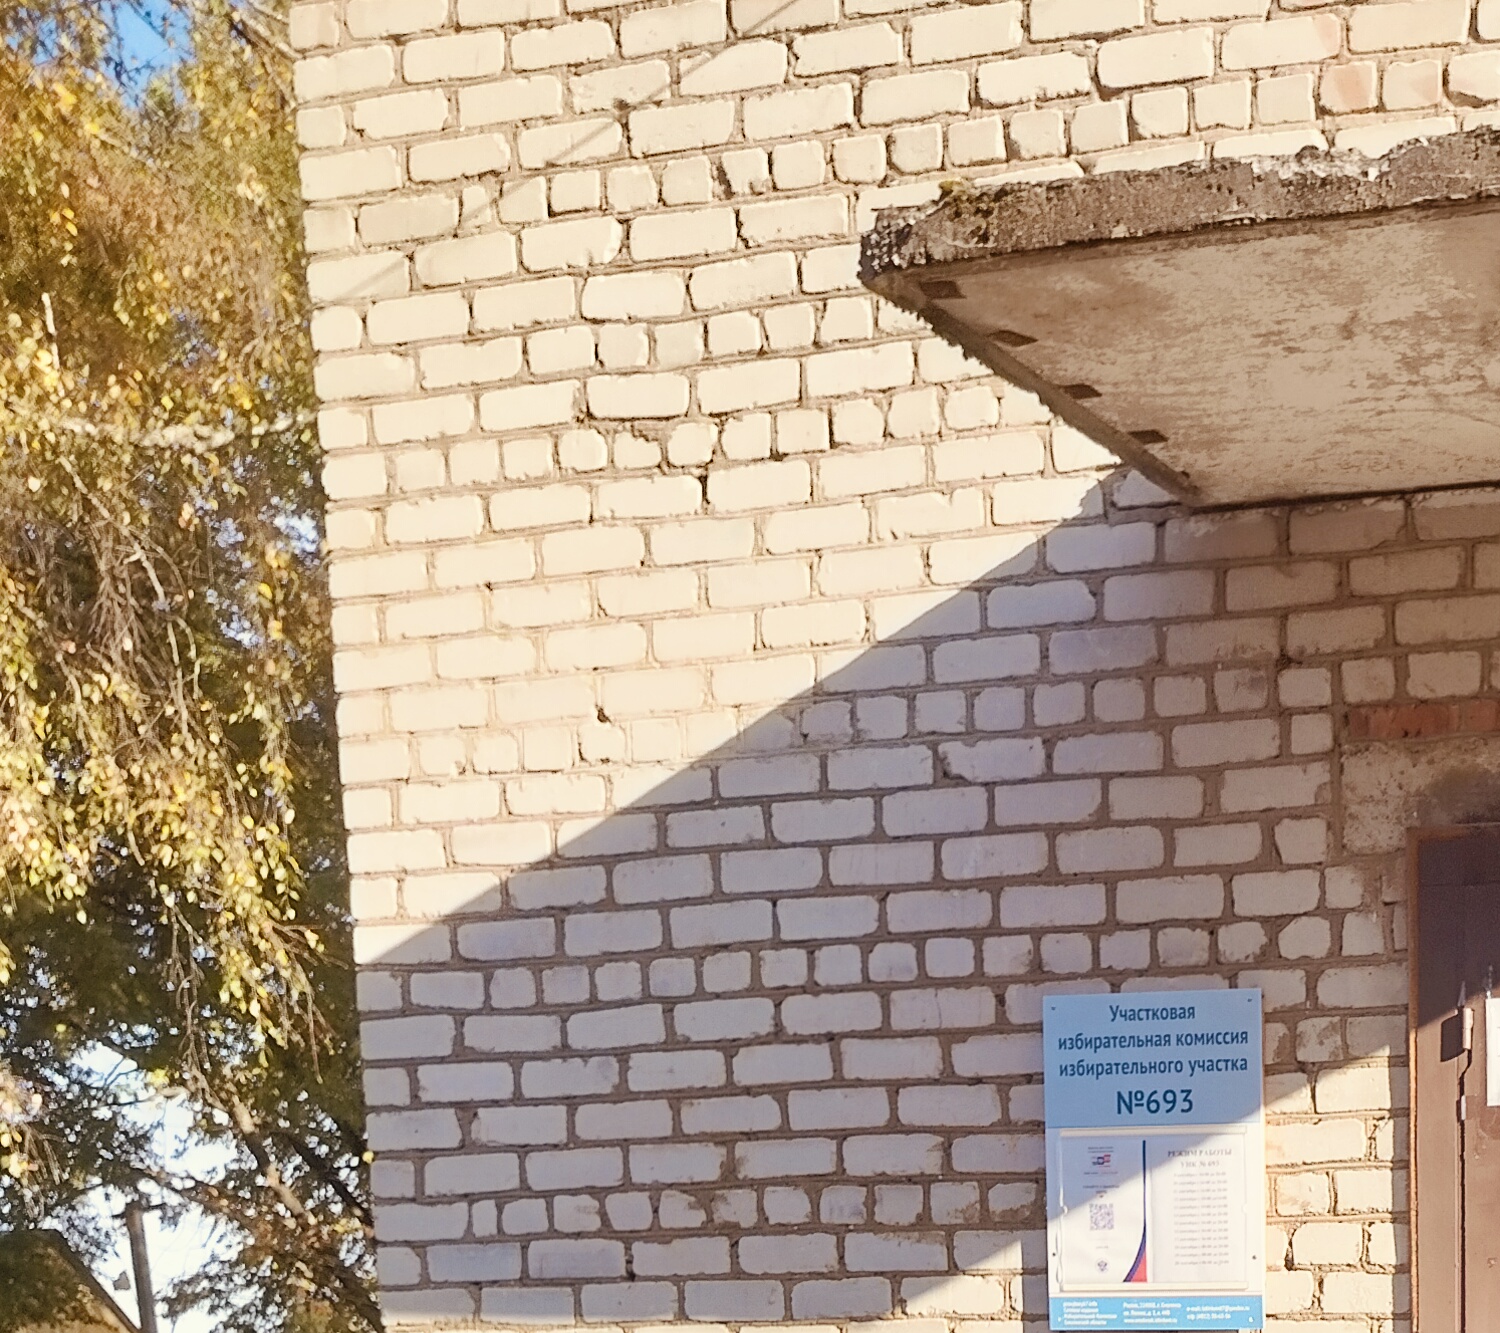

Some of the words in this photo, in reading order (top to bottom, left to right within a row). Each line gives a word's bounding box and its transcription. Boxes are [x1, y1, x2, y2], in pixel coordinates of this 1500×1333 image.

[1109, 1005, 1195, 1022] Участковая
[1058, 1032, 1171, 1053] избирательная
[1176, 1030, 1248, 1046] комиссия
[1059, 1059, 1183, 1080] избирательного
[1188, 1057, 1248, 1077] участка
[1117, 1088, 1193, 1115] №693
